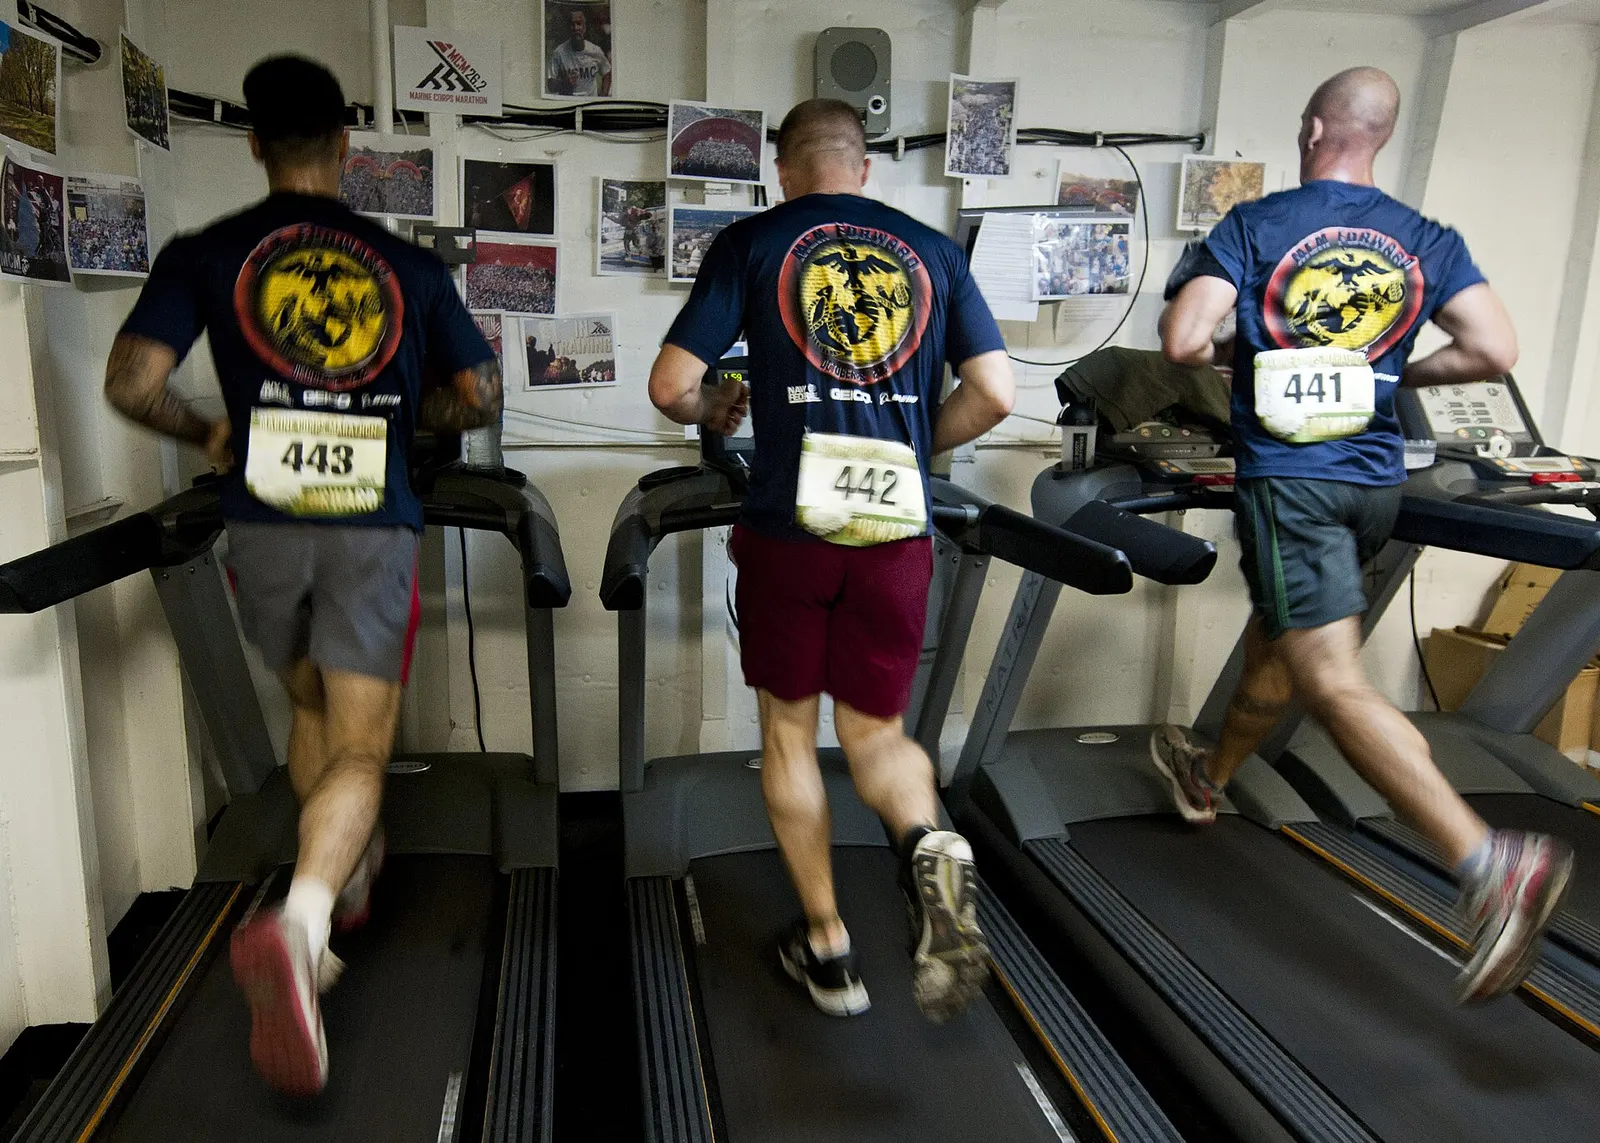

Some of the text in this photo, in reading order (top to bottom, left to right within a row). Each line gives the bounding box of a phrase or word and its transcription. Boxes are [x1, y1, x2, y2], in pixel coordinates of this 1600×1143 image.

[447, 48, 488, 93] MCM 26.2
[409, 91, 488, 105] MARINE CORPS MARATHON
[575, 319, 589, 339] IN
[554, 337, 613, 356] TRAINING
[829, 388, 872, 404] GEICO
[1283, 371, 1343, 405] 441
[281, 440, 354, 475] 443
[834, 465, 898, 506] 442
